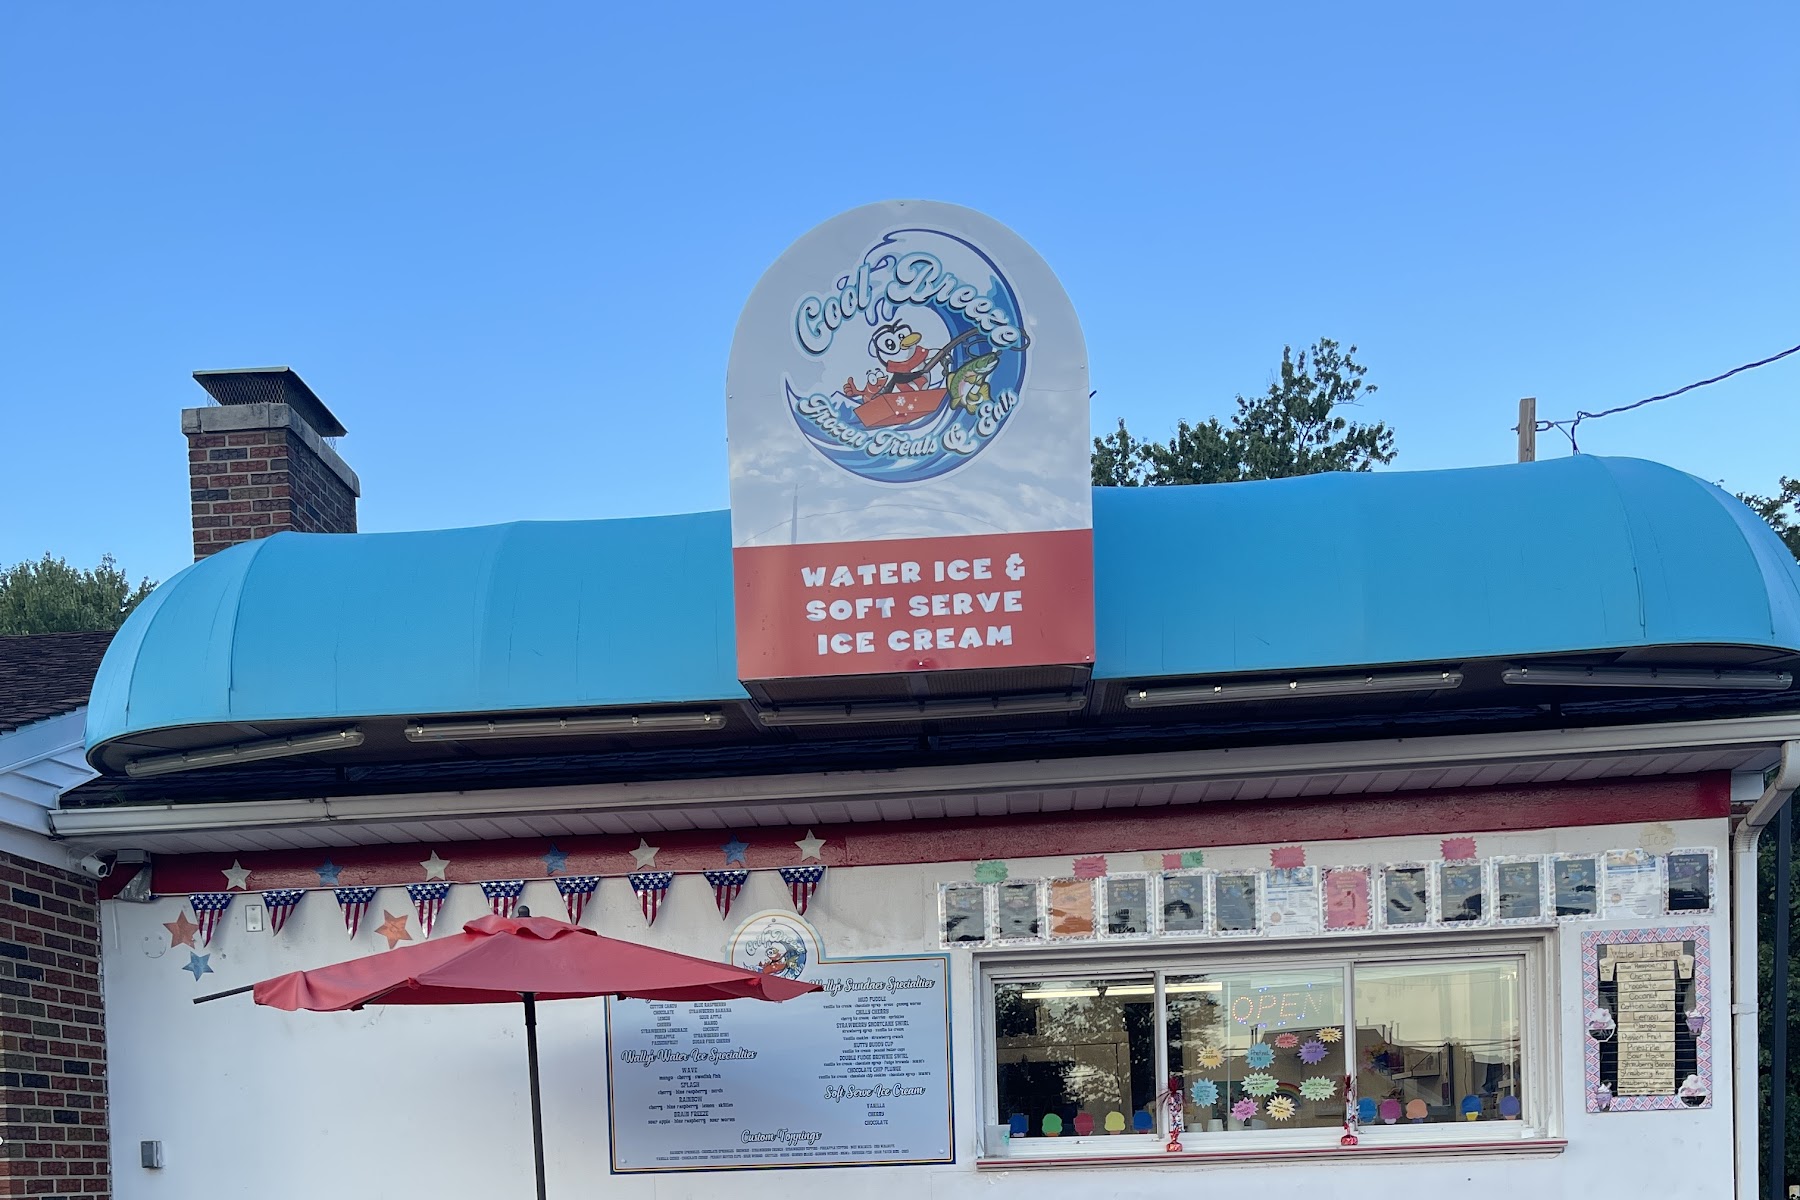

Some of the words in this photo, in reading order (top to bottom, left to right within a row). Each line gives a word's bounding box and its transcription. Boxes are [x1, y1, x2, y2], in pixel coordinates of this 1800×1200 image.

[796, 262, 871, 356] Cool
[885, 252, 1021, 348] Breeze
[798, 394, 866, 448] Frozen
[867, 431, 938, 457] Treats
[942, 423, 978, 454] &
[977, 389, 1019, 436] Eats
[801, 561, 921, 587] WATER
[934, 558, 992, 582] ICE
[1005, 553, 1025, 580] &
[806, 597, 895, 622] SOFT
[909, 590, 1023, 617] SERVE
[817, 632, 875, 655] ICE
[888, 625, 1012, 651] CREAM
[1610, 945, 1637, 958] Water
[844, 977, 884, 993] Sundaes
[886, 975, 936, 995] Specialties
[1629, 972, 1652, 980] Cherry
[1623, 982, 1658, 990] Chocolate
[1629, 991, 1658, 1000] Coconut
[1232, 992, 1324, 1021] OPEN
[1620, 1001, 1644, 1010] Cotton
[1647, 1001, 1669, 1011] Candy
[1633, 1012, 1659, 1020] Lemon
[1633, 1023, 1656, 1031] Mango
[1627, 1042, 1660, 1051] Pineapple
[621, 1049, 657, 1068] Wally's
[657, 1048, 689, 1062] Water
[690, 1047, 708, 1062] Ice
[709, 1046, 757, 1065] Specialties
[1621, 1060, 1653, 1069] Strawberry
[824, 1085, 846, 1103] Soft
[846, 1084, 873, 1098] Serve
[874, 1083, 892, 1098] Ice
[892, 1082, 926, 1097] Cream
[741, 1129, 776, 1144] Custom
[776, 1128, 822, 1146] Toppings
